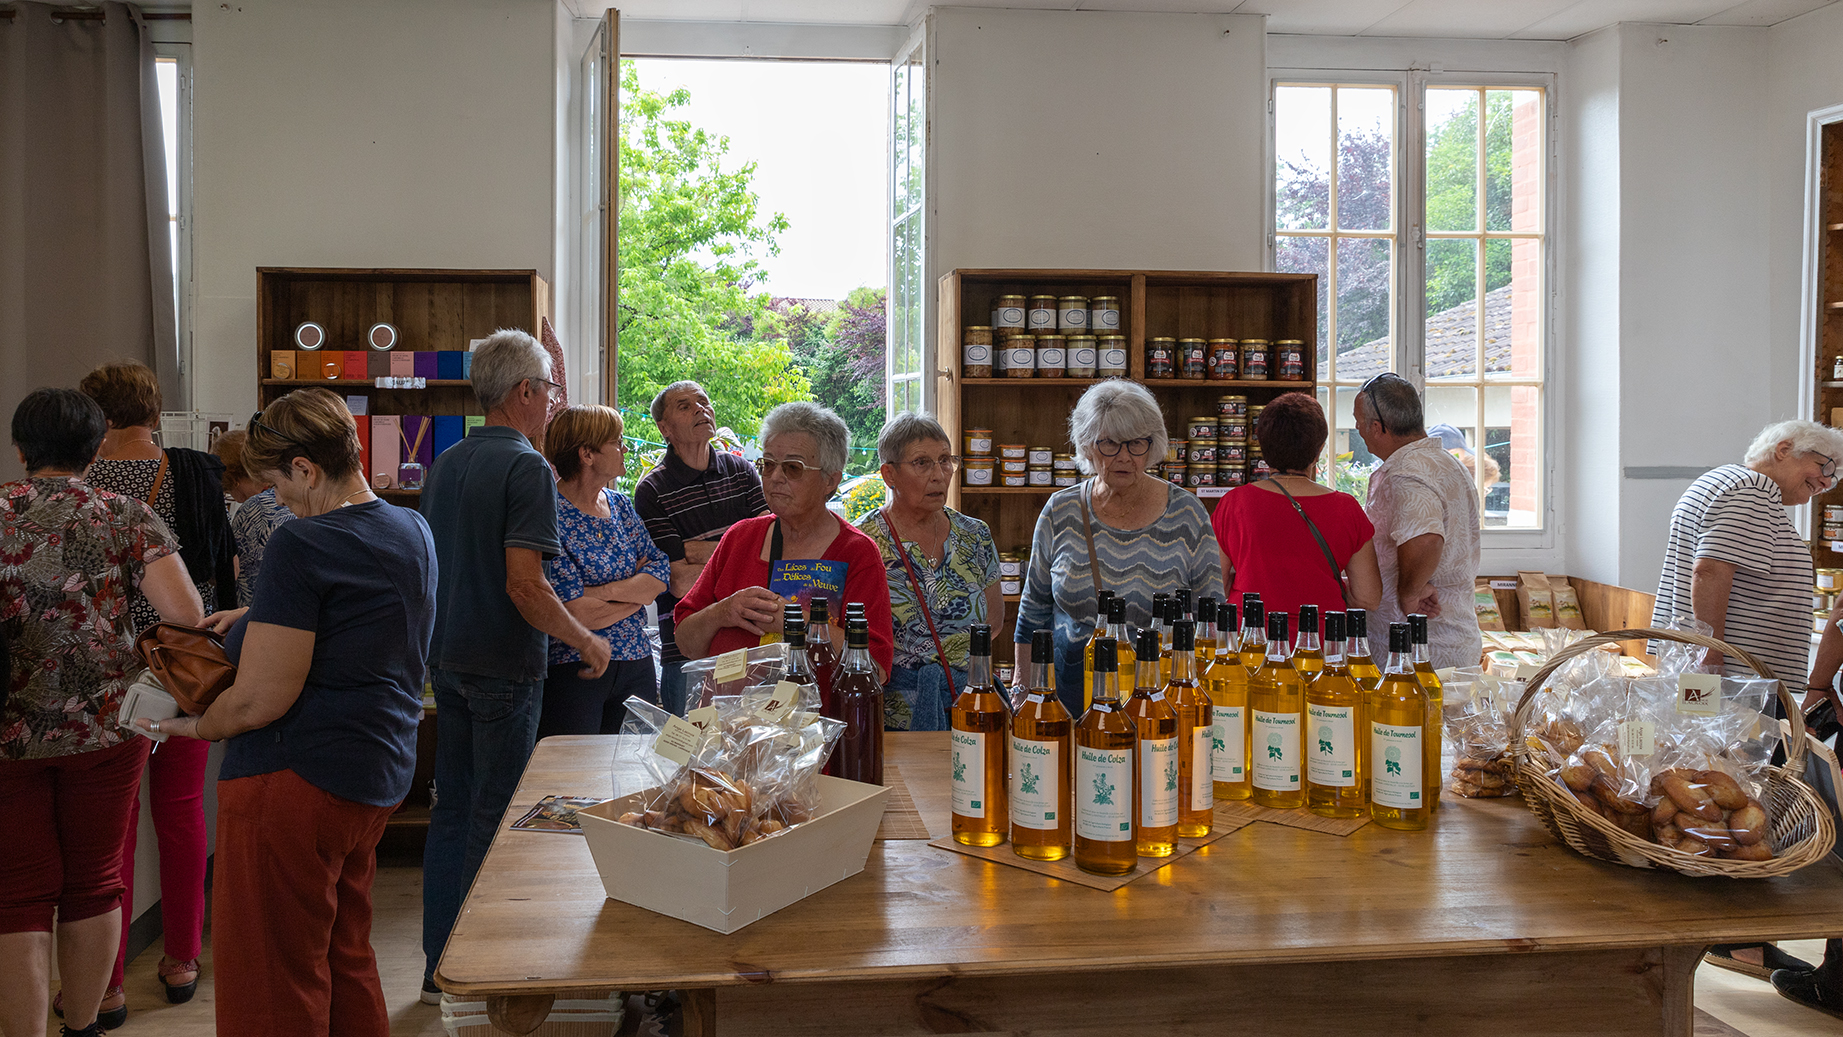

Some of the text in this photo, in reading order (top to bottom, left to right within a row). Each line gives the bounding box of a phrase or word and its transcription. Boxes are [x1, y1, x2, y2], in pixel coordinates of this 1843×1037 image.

[785, 562, 807, 572] Lices
[816, 562, 832, 572] Fou
[812, 579, 838, 592] Veuve
[1322, 710, 1348, 718] Tournesol
[1272, 717, 1296, 725] Tournesol
[1383, 728, 1390, 736] de
[1390, 730, 1416, 738] Tournesol
[960, 735, 976, 746] Colza
[1024, 745, 1031, 754] de
[1032, 746, 1050, 755] Colza
[1152, 744, 1167, 752] Huile
[1168, 742, 1174, 751] de
[1082, 751, 1126, 764] Huile de Colza
